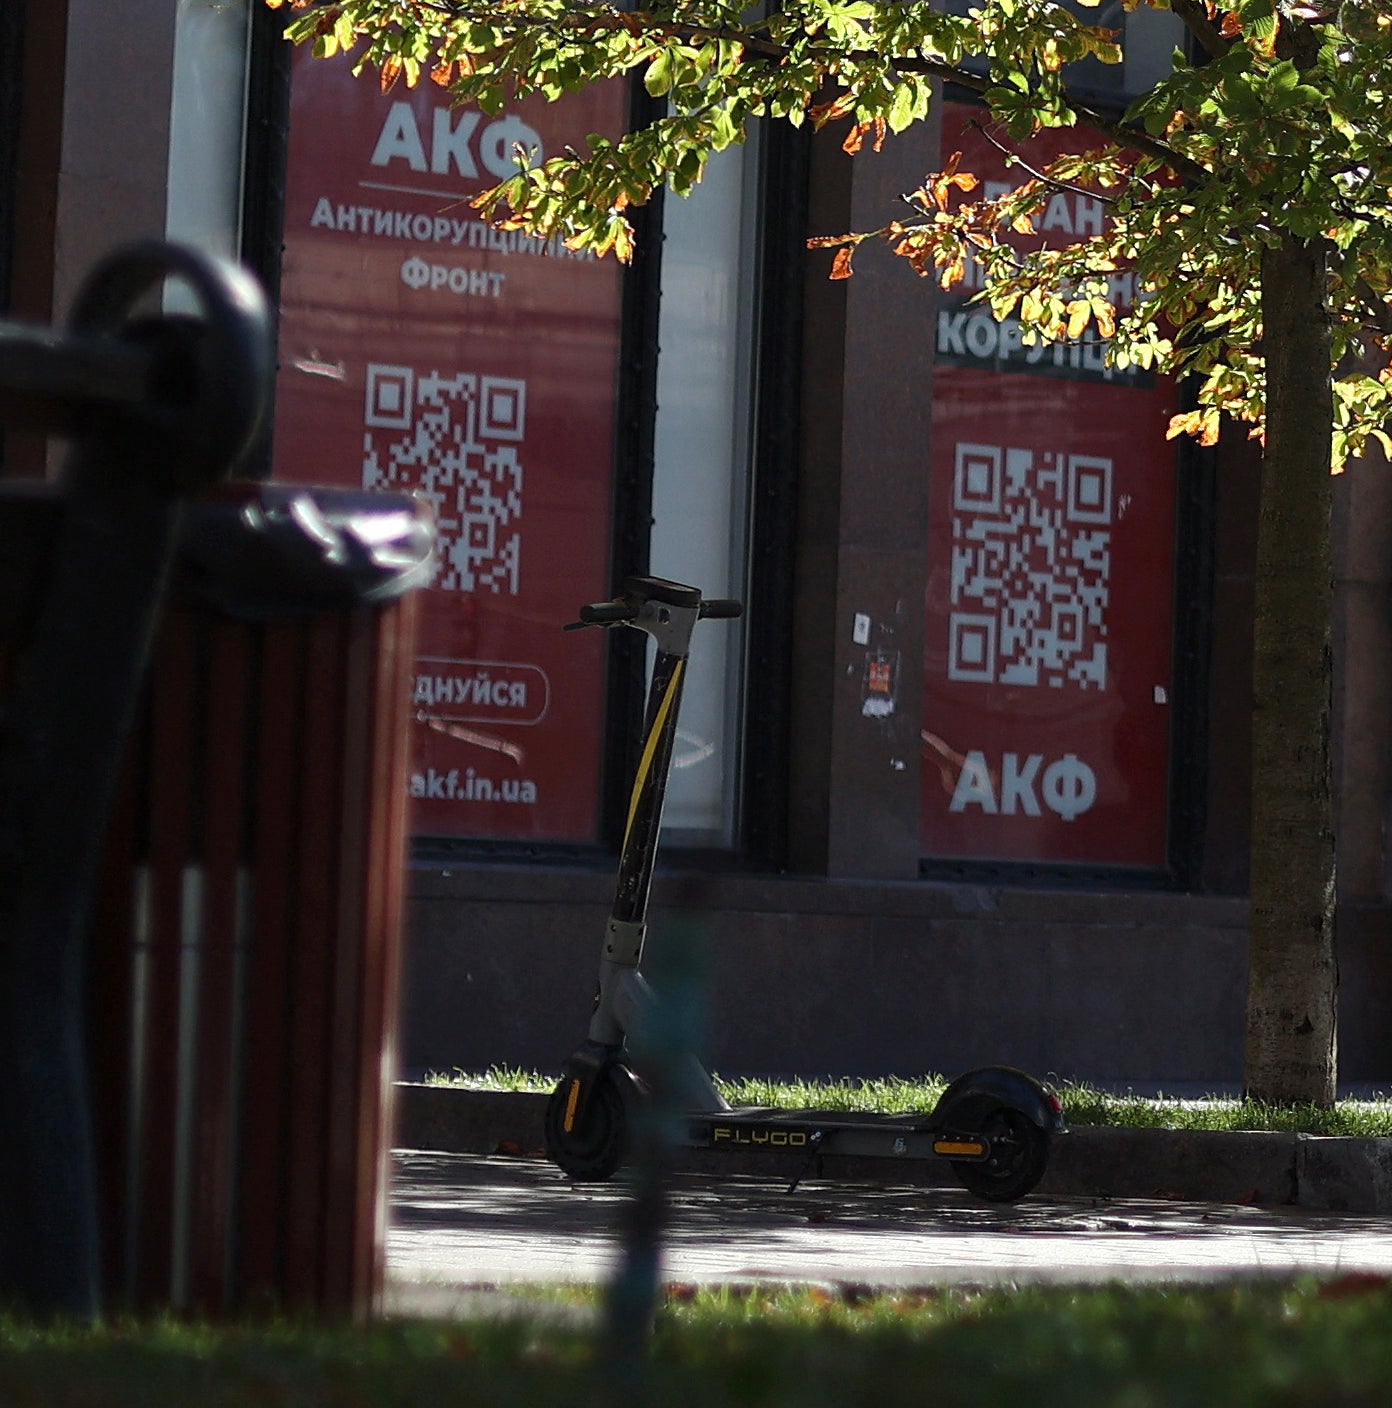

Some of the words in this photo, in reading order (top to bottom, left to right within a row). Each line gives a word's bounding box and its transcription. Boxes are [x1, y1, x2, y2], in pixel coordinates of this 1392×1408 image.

[371, 101, 544, 181] АКФ
[401, 256, 505, 298] ФРОНТ
[410, 767, 538, 805] akf.in.ua
[949, 749, 1097, 822] АКФ
[714, 1128, 807, 1145] FLYGO
